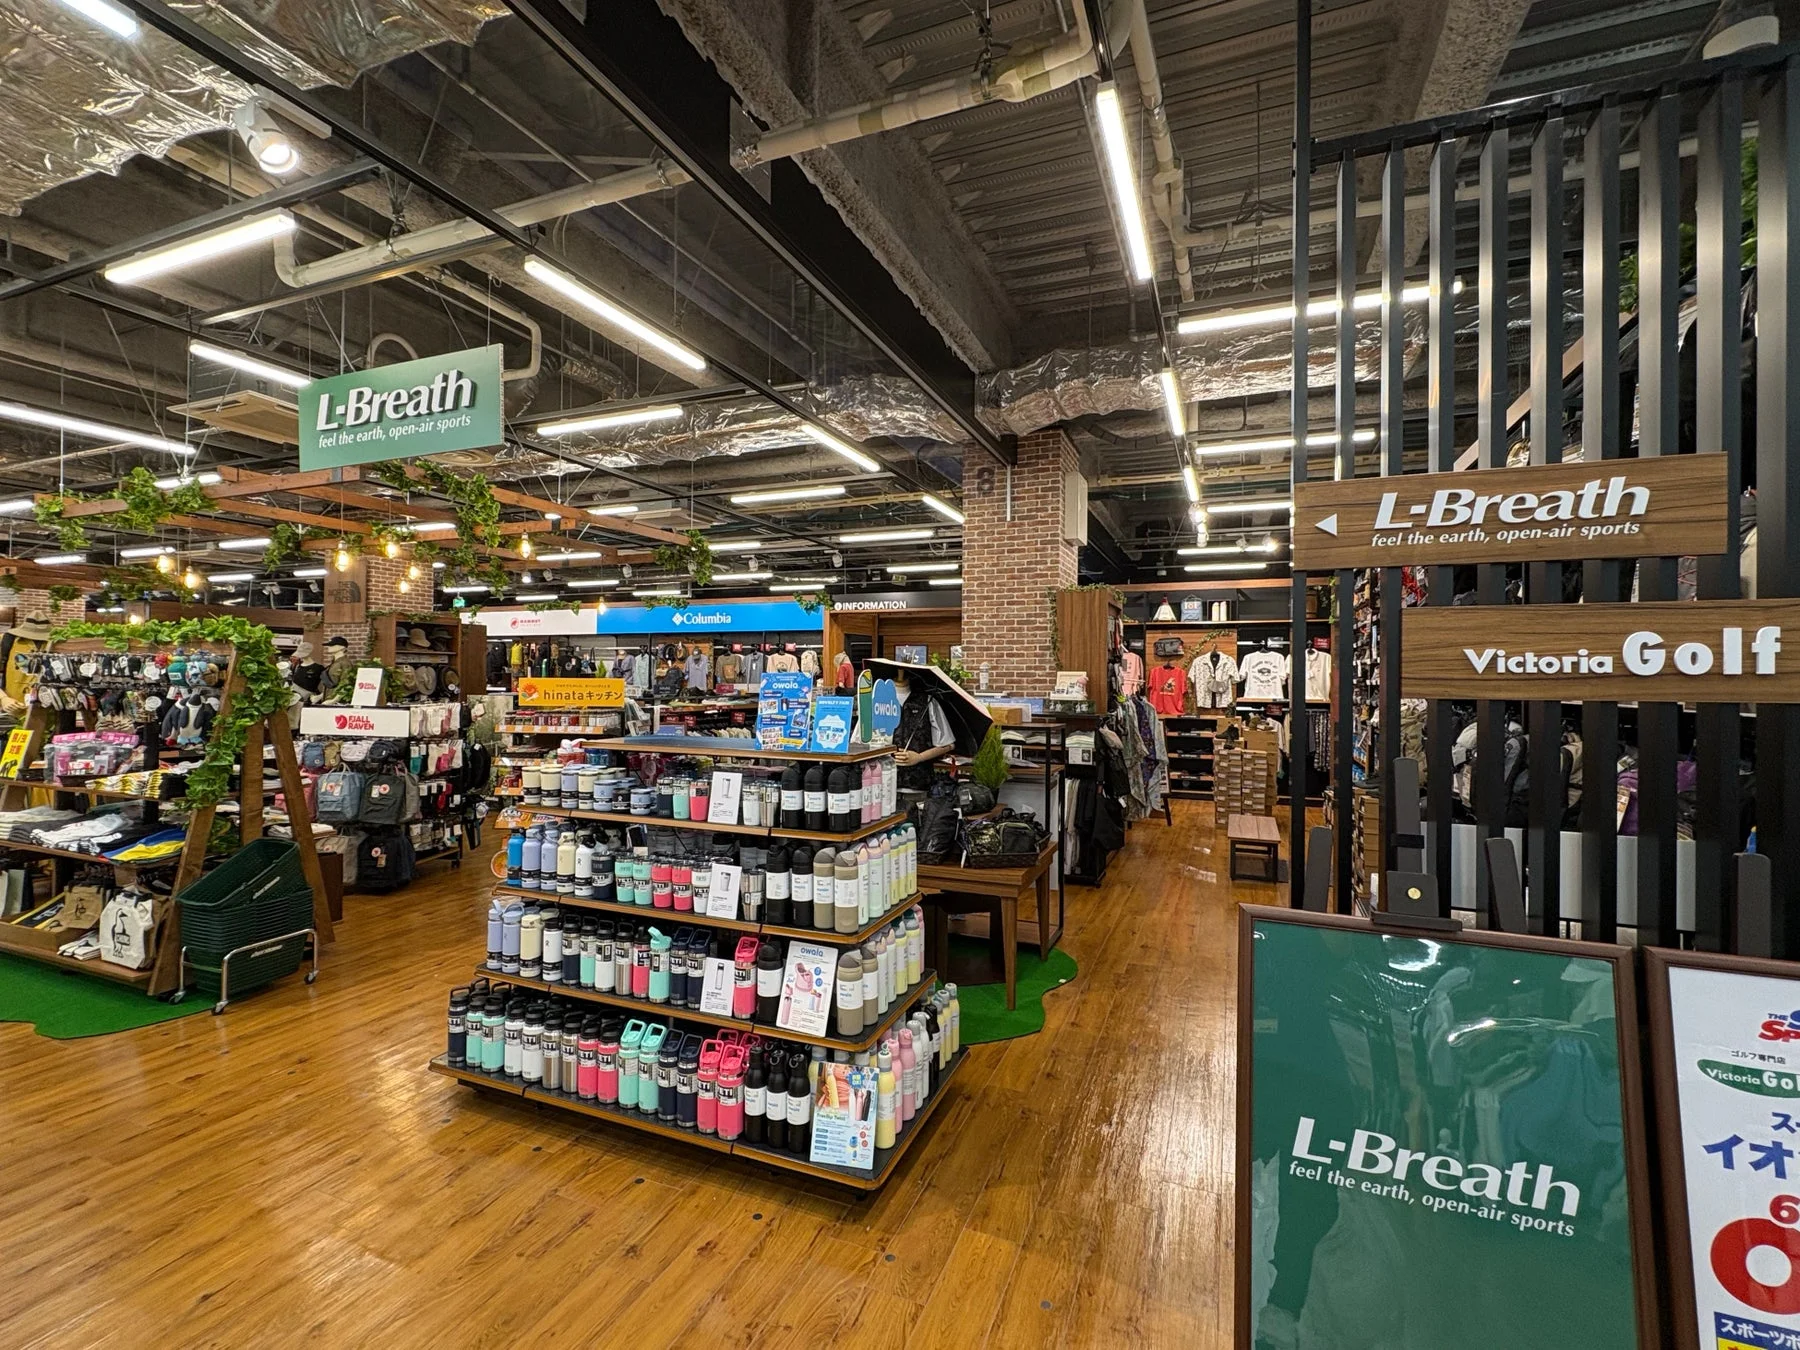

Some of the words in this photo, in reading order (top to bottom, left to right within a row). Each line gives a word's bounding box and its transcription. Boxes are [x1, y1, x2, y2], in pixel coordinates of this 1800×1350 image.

[316, 369, 475, 431] L-Breath
[318, 433, 337, 449] feel
[338, 431, 354, 445] the
[356, 427, 387, 442] earth,
[388, 418, 434, 440] open-air
[436, 413, 472, 434] sports
[1374, 476, 1651, 530] L-Breath
[1371, 533, 1402, 547] feel
[1407, 531, 1434, 545] the
[1439, 528, 1490, 544] earth,
[1496, 526, 1575, 545] open-air
[1580, 521, 1640, 541] sports
[842, 600, 907, 611] INFORMATION
[683, 612, 732, 625] Columbia
[1462, 648, 1614, 675] Victoria
[1622, 626, 1782, 676] Golf
[772, 681, 799, 689] owala
[543, 689, 623, 701] hinataキッチン
[874, 699, 898, 717] owala
[800, 946, 824, 957] owala
[1768, 1013, 1788, 1021] THE
[1731, 1050, 1786, 1065] ゴルフ専門店
[1706, 1067, 1761, 1085] Victoria
[1771, 1112, 1800, 1134] ス
[1291, 1116, 1581, 1217] L-Breath
[1289, 1160, 1322, 1181] feel
[1327, 1169, 1356, 1189] the
[1361, 1180, 1416, 1206] earth,
[1421, 1193, 1506, 1222] open-air
[1510, 1212, 1576, 1238] sports
